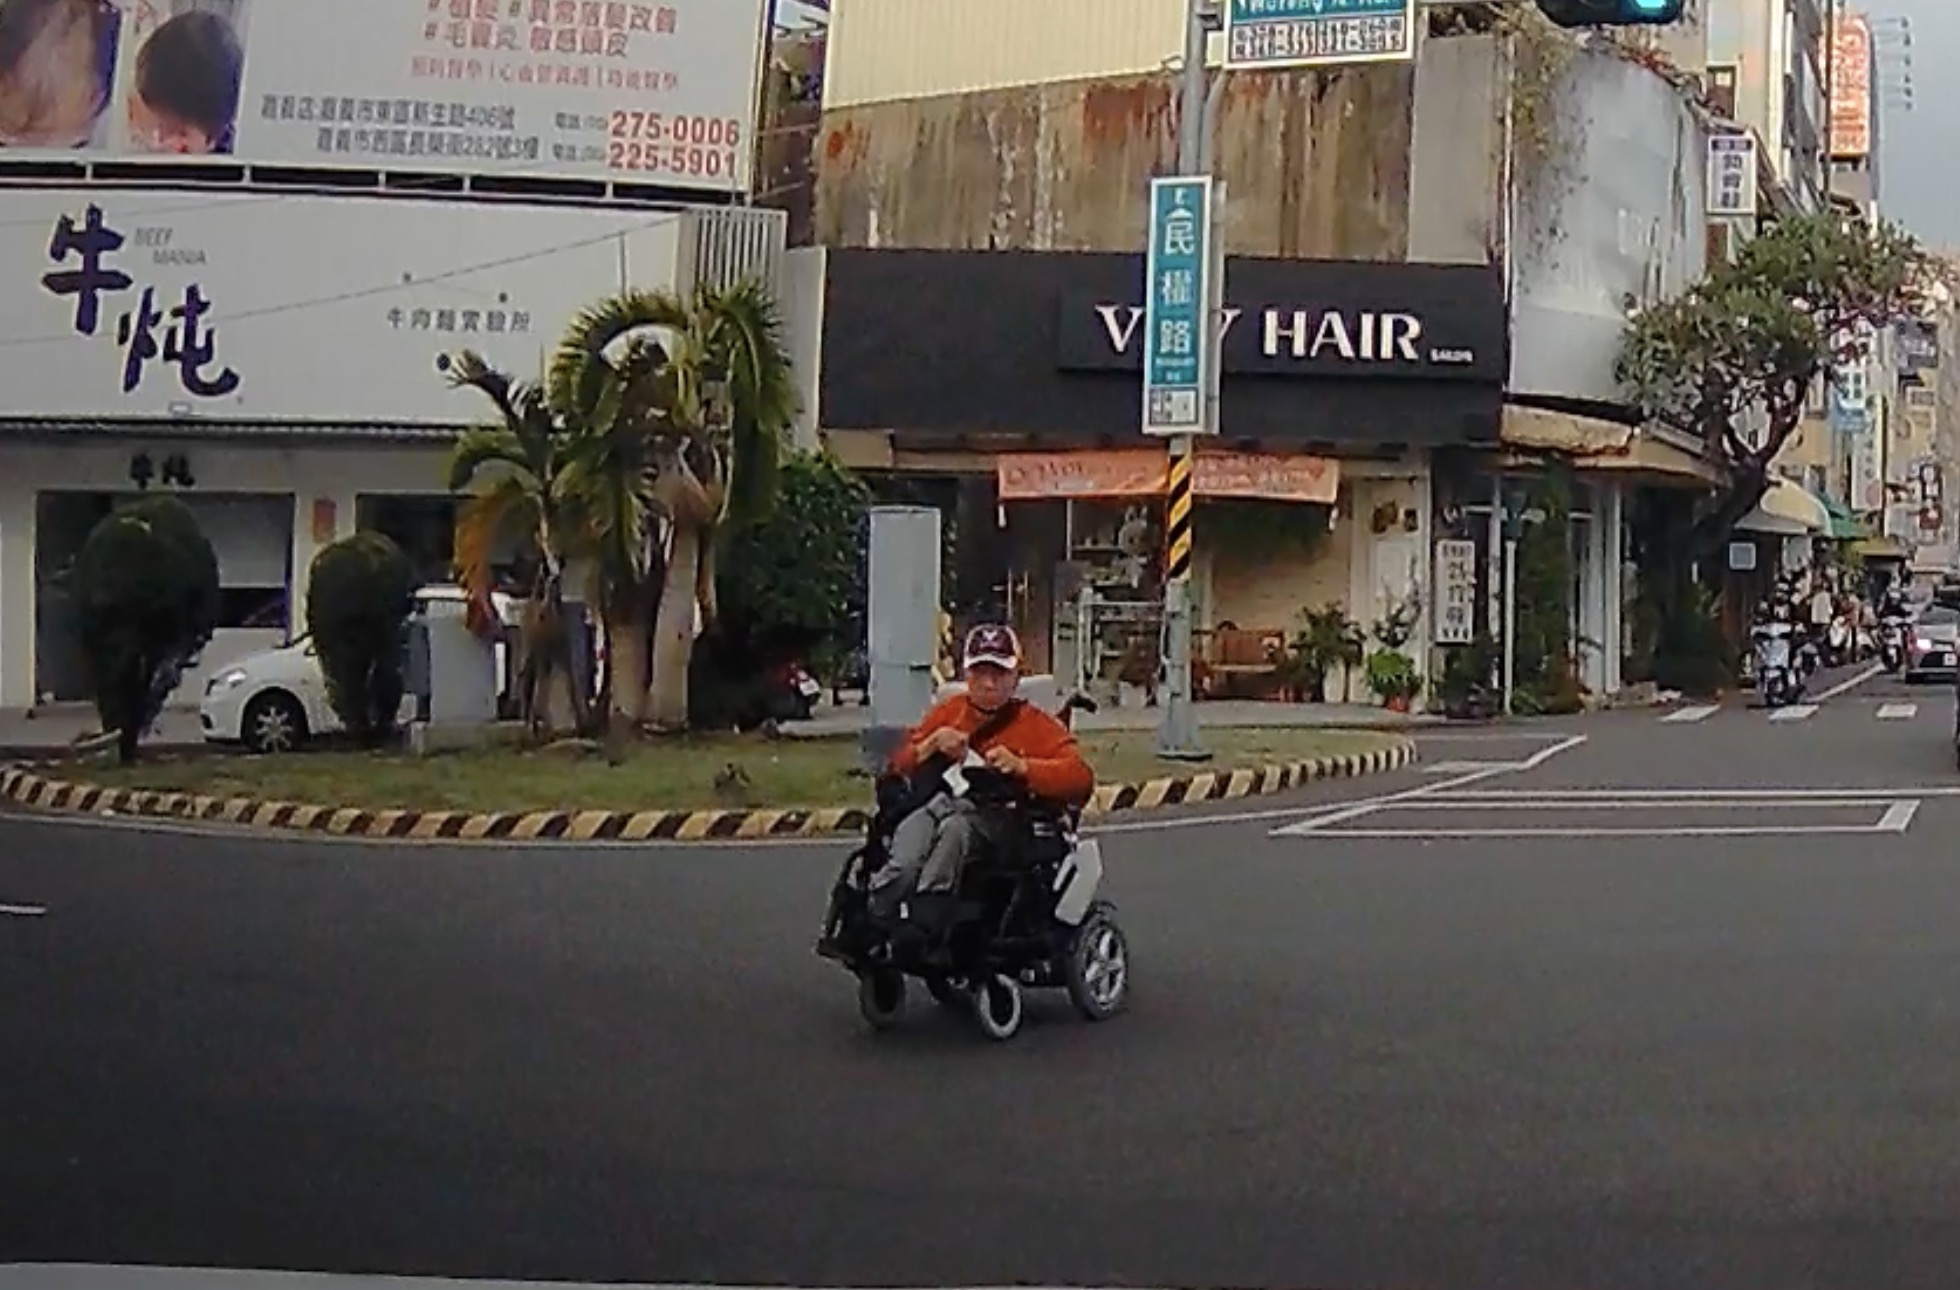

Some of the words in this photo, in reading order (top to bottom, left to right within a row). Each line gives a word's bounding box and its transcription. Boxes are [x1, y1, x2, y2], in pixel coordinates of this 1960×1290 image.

[611, 110, 740, 147] 275-0006
[608, 142, 737, 178] 225-5901
[1160, 221, 1195, 355] 民權路
[1262, 309, 1422, 361] HAIR
